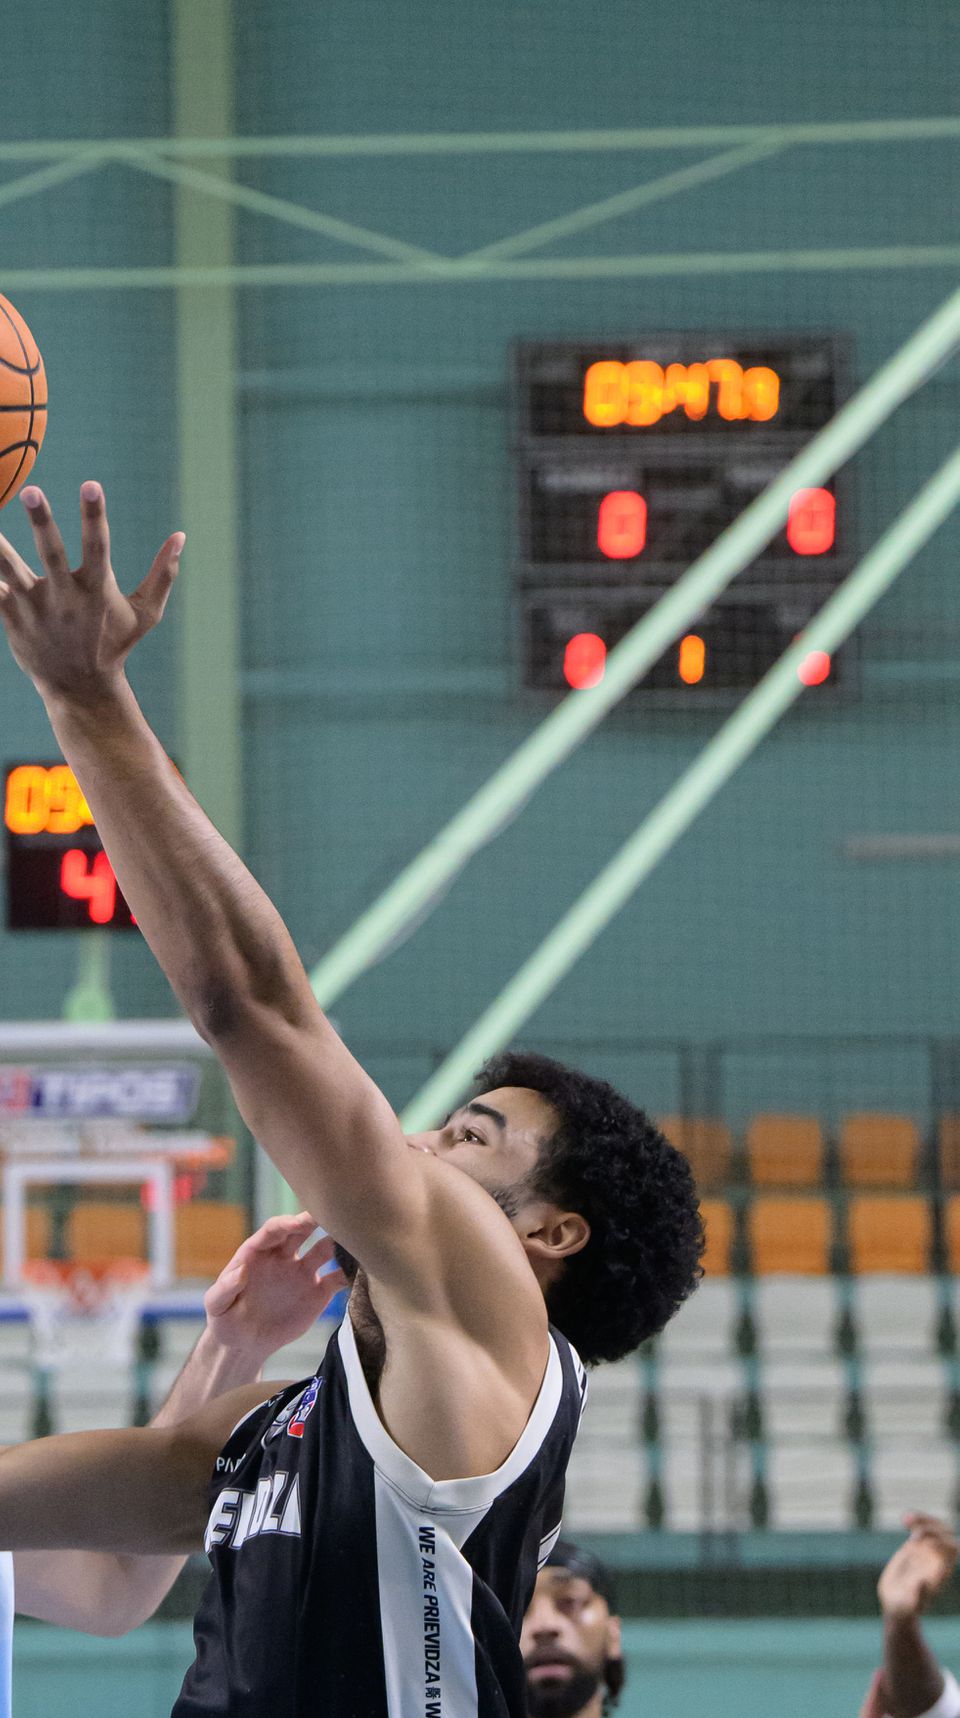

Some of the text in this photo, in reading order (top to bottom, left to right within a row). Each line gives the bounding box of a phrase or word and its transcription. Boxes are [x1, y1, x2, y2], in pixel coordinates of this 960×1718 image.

[597, 490, 647, 559] 0
[418, 1525, 436, 1555] WE
[421, 1557, 437, 1593] ARE
[423, 1594, 441, 1684] PRIEVIDZA
